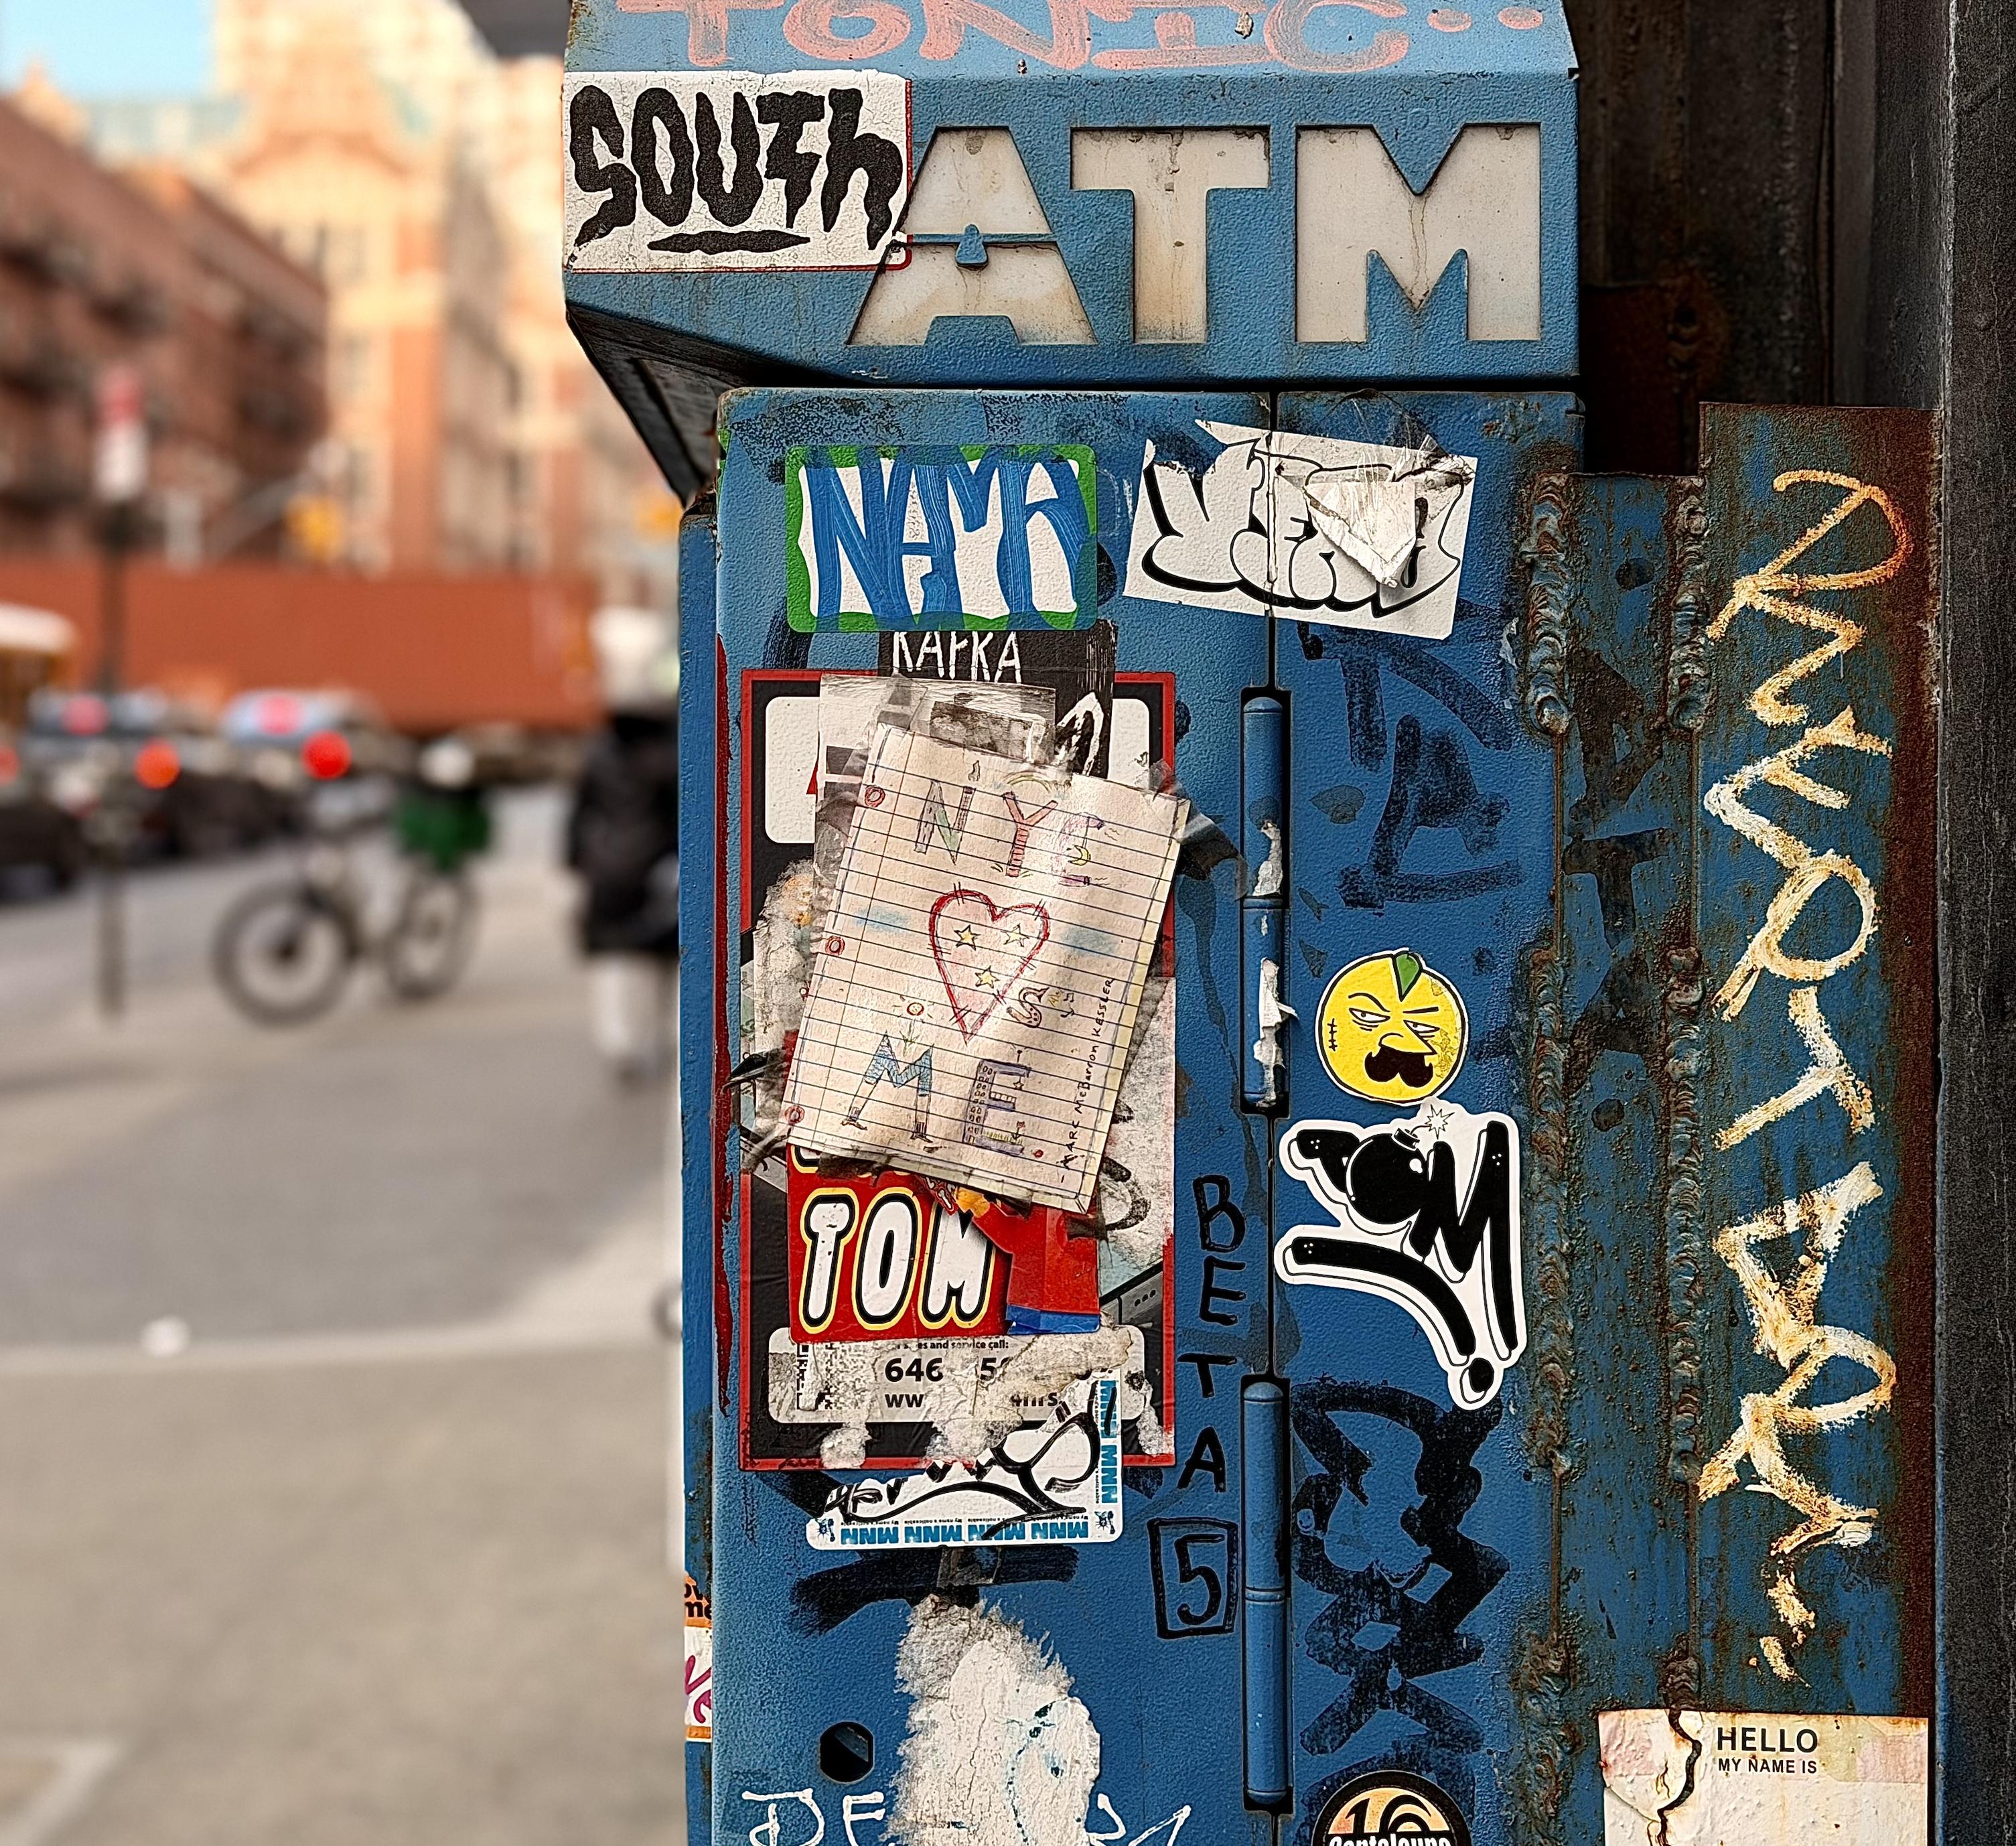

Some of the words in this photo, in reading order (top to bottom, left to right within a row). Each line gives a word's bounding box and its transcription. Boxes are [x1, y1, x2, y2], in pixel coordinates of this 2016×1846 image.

[845, 123, 1540, 346] ATM
[1092, 977, 1116, 1036] KESSLER
[841, 1032, 1032, 1157] ME
[804, 1194, 995, 1326] TOM
[930, 1340, 949, 1349] and
[1177, 1174, 1247, 1493] BETA
[885, 1357, 944, 1382] 646
[1101, 1445, 1118, 1504] MNN
[841, 1527, 899, 1545] MNN
[905, 1525, 962, 1543] MNN
[1031, 1522, 1088, 1539] MNN
[1717, 1726, 1818, 1754] HELLO
[1718, 1759, 1741, 1773] MY
[1747, 1758, 1796, 1774] NAME
[1802, 1760, 1818, 1774] IS
